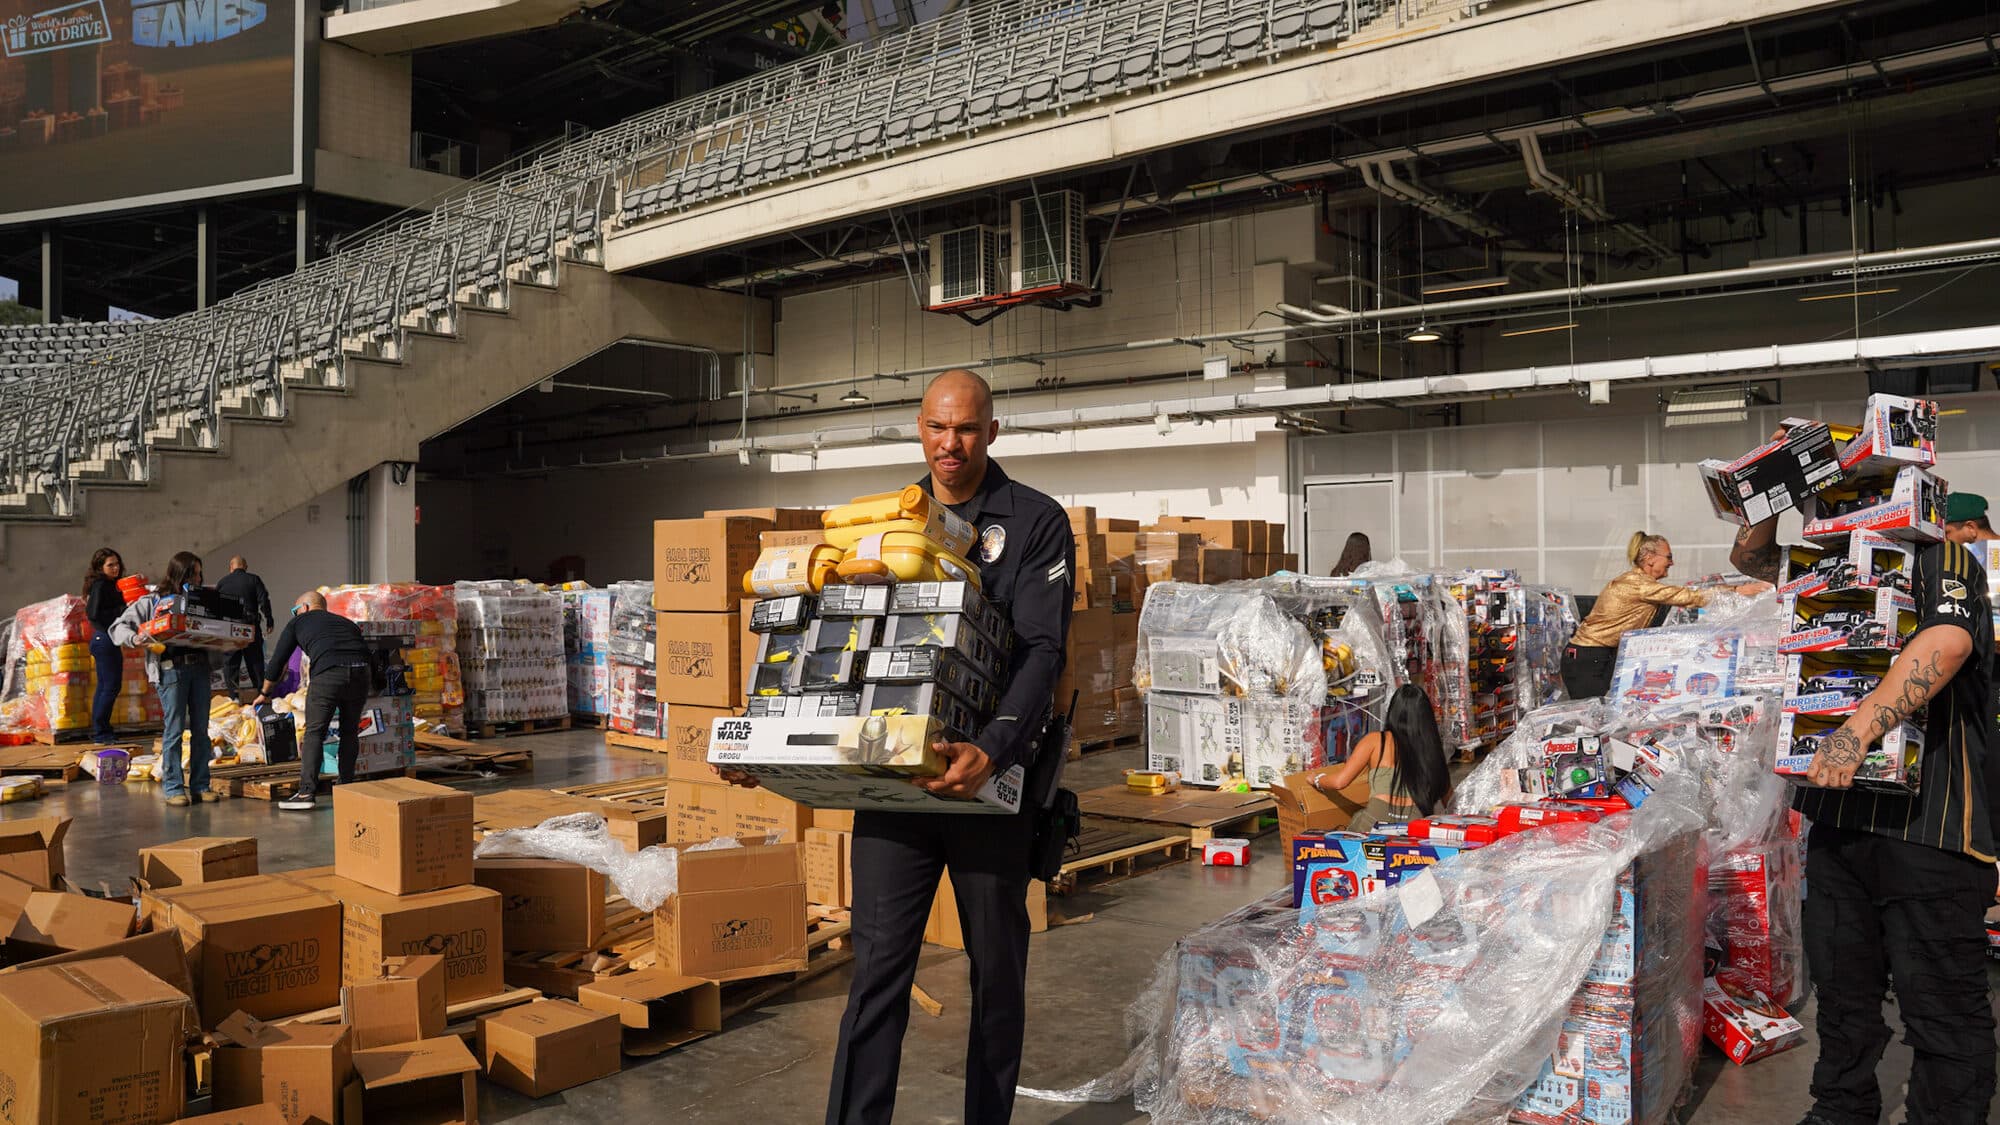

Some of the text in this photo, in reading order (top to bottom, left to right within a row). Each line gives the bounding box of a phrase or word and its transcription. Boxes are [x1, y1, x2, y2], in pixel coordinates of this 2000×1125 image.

[31, 13, 93, 31] World's Largest
[31, 20, 103, 46] TOY DRIVE
[1883, 507, 1909, 520] FORD
[666, 562, 711, 584] WORLD
[1823, 612, 1849, 622] POLICE
[1780, 628, 1831, 645] FORD F-150
[1787, 633, 1839, 650] POLICE TRUCK
[668, 655, 714, 678] WORLD
[1784, 697, 1810, 708] FORD
[1800, 700, 1850, 713] SUPER DUTY
[717, 721, 753, 731] STAR
[717, 730, 752, 741] WARS
[1543, 740, 1577, 755] AVENGERS
[718, 752, 741, 761] GROGU
[1776, 758, 1802, 768] FORD
[1791, 764, 1810, 773] SUP
[1296, 847, 1345, 861] SPIDER-MAN
[1389, 853, 1438, 868] SPIDER-MAN
[712, 918, 773, 939] WORLD
[401, 927, 488, 960] WORLD
[224, 937, 321, 979] WORLD
[447, 955, 488, 980] TOYS
[224, 964, 321, 1001] TECH TOYS
